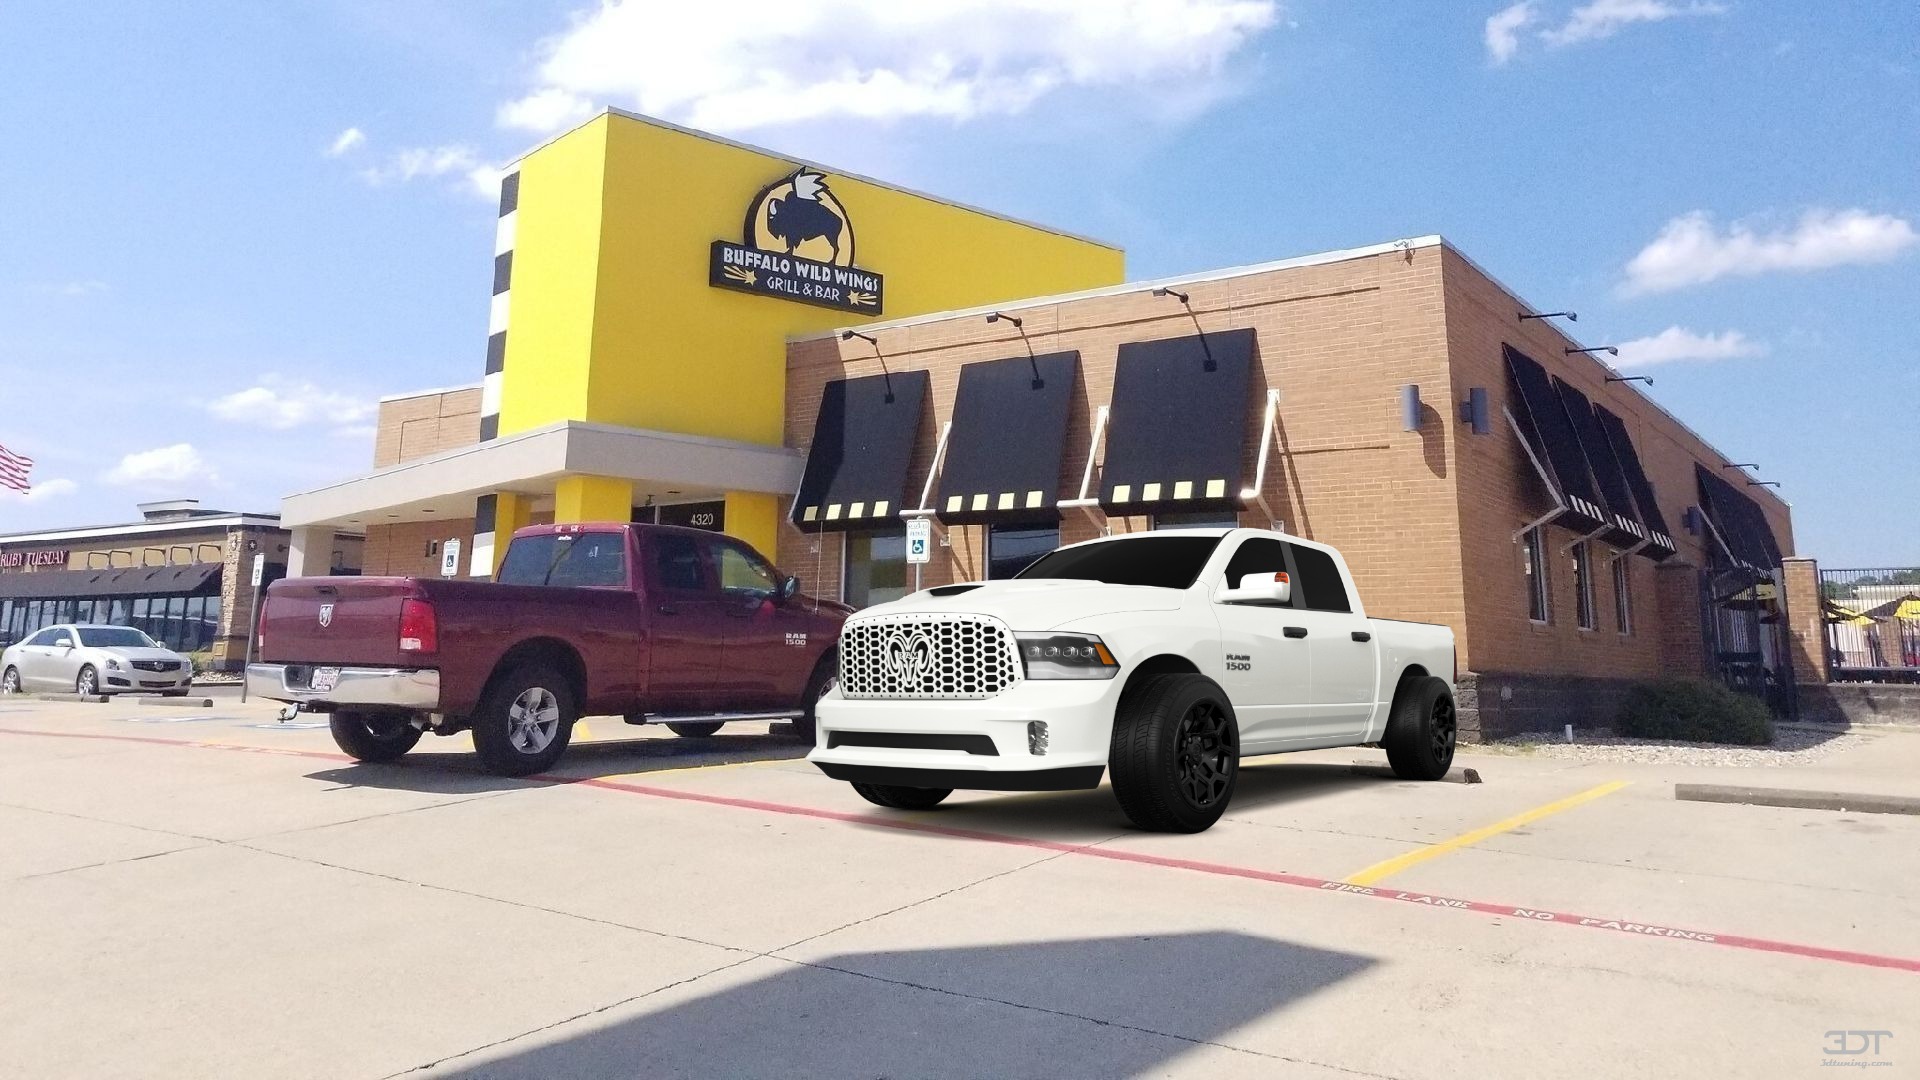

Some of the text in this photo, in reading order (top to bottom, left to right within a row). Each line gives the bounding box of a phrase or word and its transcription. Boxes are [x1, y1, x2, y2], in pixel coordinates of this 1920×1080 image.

[723, 247, 878, 292] BUFFALO WILD WINGS
[767, 276, 840, 302] GRILL & BAR
[690, 513, 714, 526] 4320
[0, 550, 66, 567] RUBY TUESDAY
[897, 651, 919, 660] RAM
[1226, 662, 1251, 671] 1500
[1320, 882, 1716, 942] FIRE LANE NO PARKING
